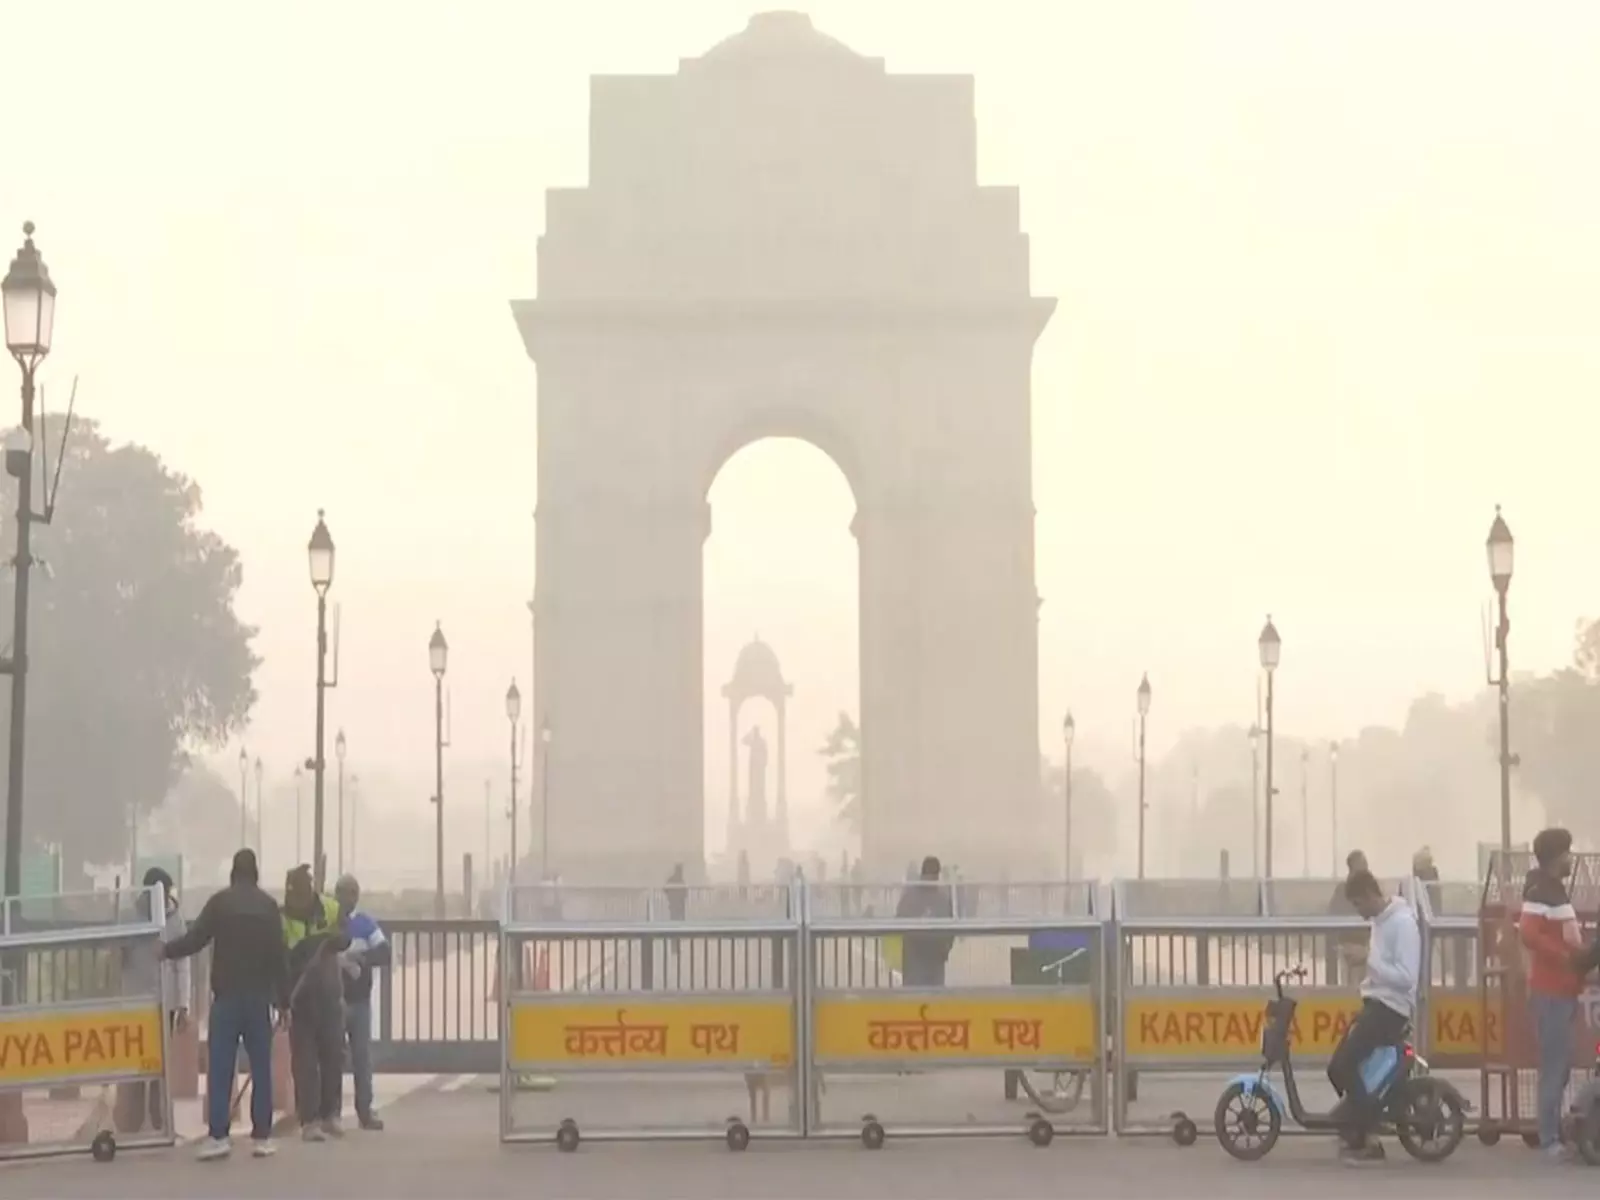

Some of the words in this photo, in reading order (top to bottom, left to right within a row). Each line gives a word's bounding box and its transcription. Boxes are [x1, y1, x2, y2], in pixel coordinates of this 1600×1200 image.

[64, 1024, 144, 1064] PATH
[691, 1024, 740, 1055] पथ
[992, 1018, 1043, 1051] पथ
[1140, 1011, 1303, 1045] KARTAVA
